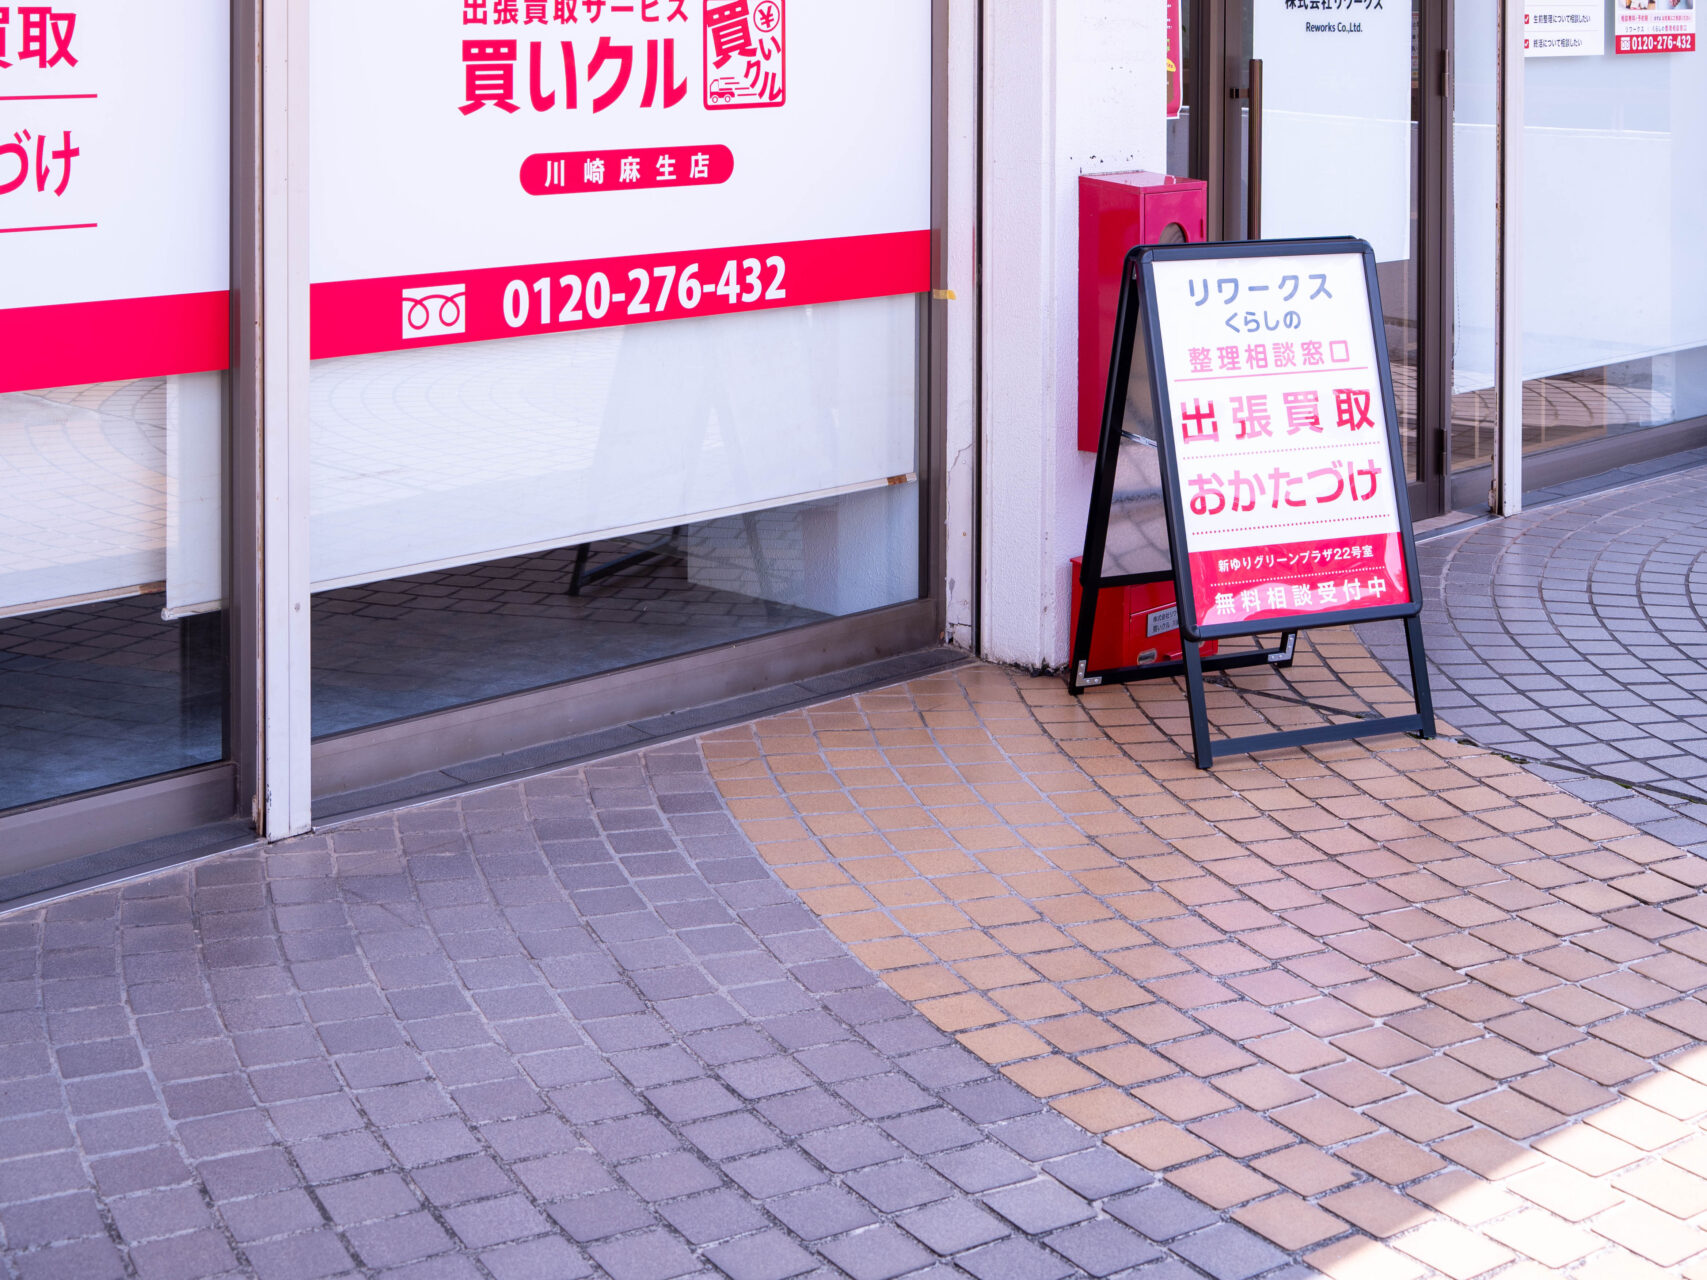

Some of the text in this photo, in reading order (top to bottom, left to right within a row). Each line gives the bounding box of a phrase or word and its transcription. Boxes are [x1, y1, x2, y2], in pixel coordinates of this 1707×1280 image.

[0, 6, 79, 69] 取
[1305, 21, 1336, 33] Reworks
[1632, 35, 1692, 51] 0120-276-432
[457, 36, 688, 116] 買いクル
[544, 152, 710, 189] 川崎麻生店
[502, 255, 787, 328] 0120-276-432
[1188, 272, 1333, 307] リワークス
[1224, 309, 1301, 333] くらしの
[1188, 339, 1351, 374] 整理相談窓口
[1180, 388, 1376, 445] 出張買取
[1187, 459, 1382, 517] おかたづけ
[1217, 544, 1374, 574] 新ゆりグリーンプラザ22号室
[1214, 575, 1388, 616] 無料相談受付中
